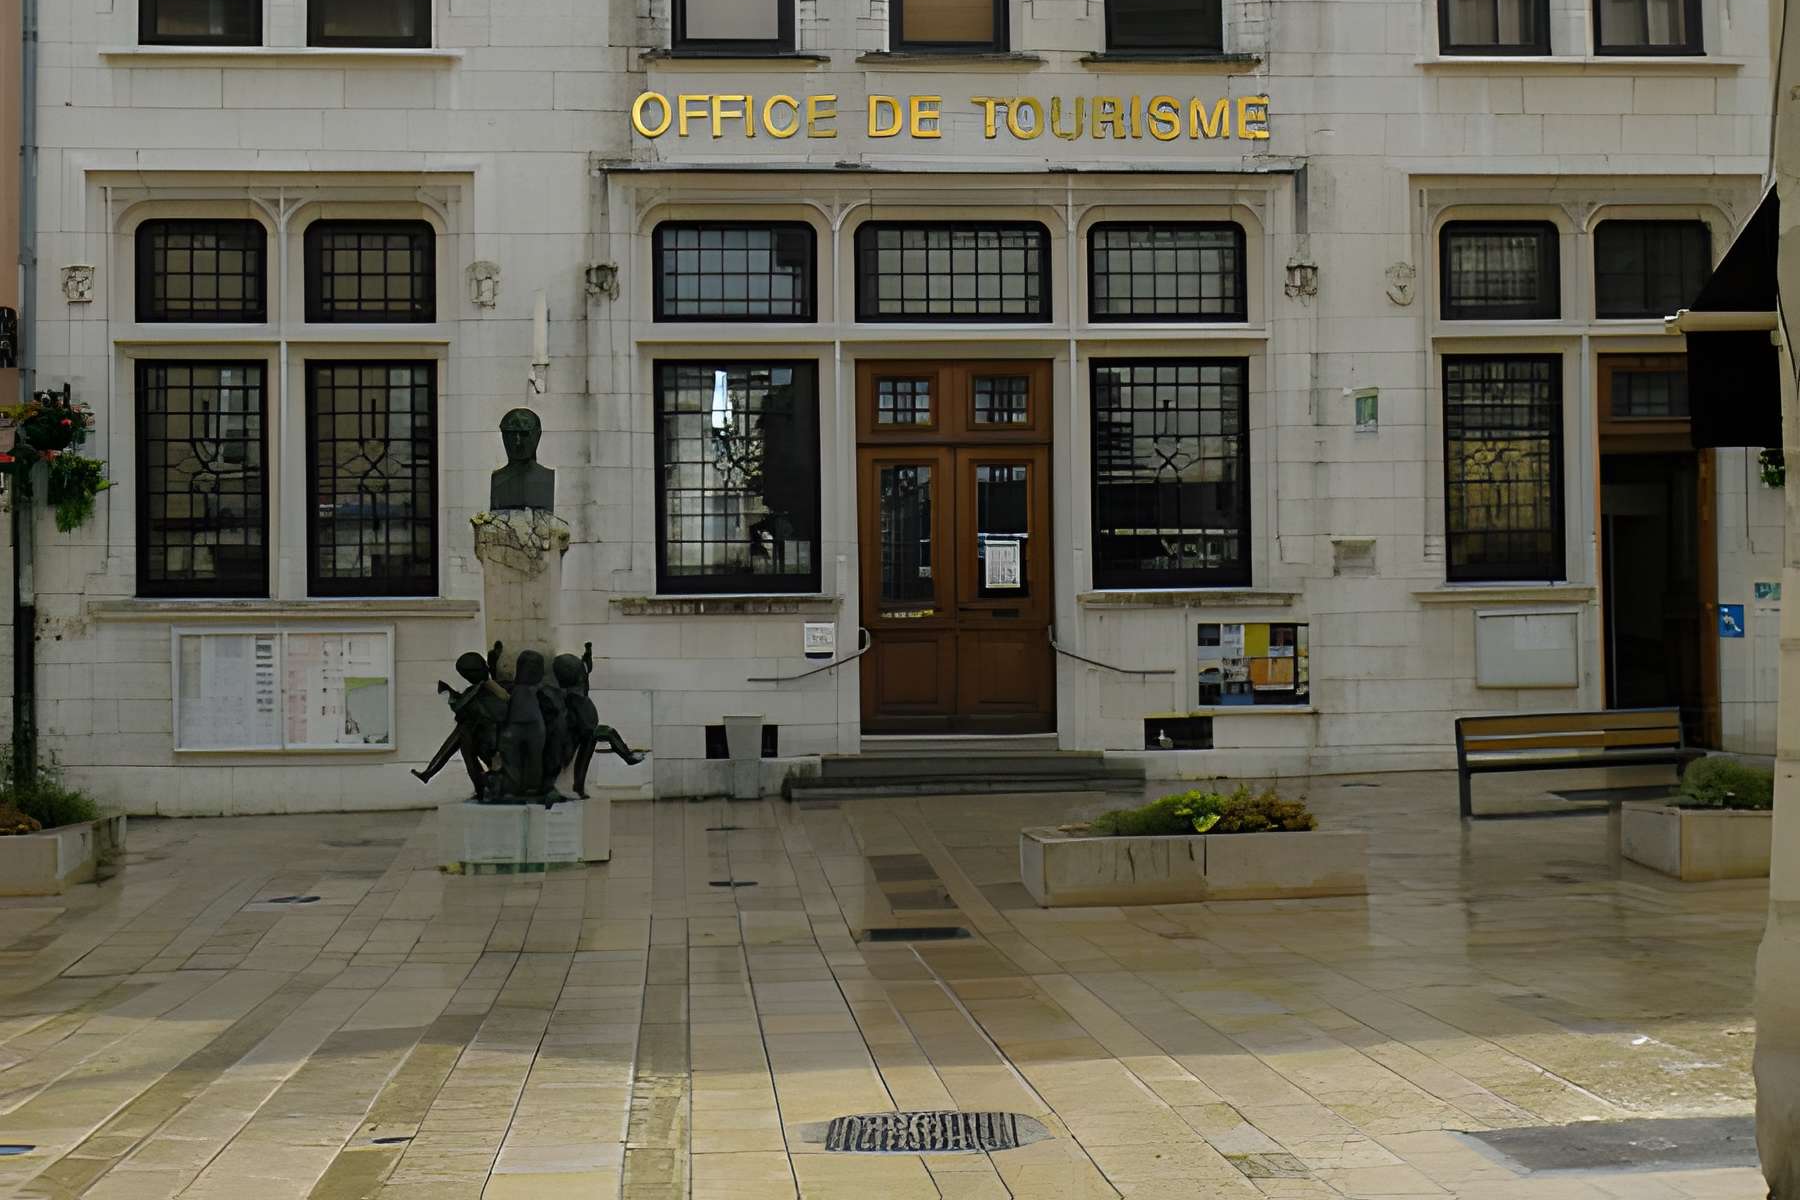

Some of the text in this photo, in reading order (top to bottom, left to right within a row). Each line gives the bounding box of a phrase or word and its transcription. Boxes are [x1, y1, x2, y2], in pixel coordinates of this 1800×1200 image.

[632, 91, 1269, 140] OFFICE DE TOURISME
